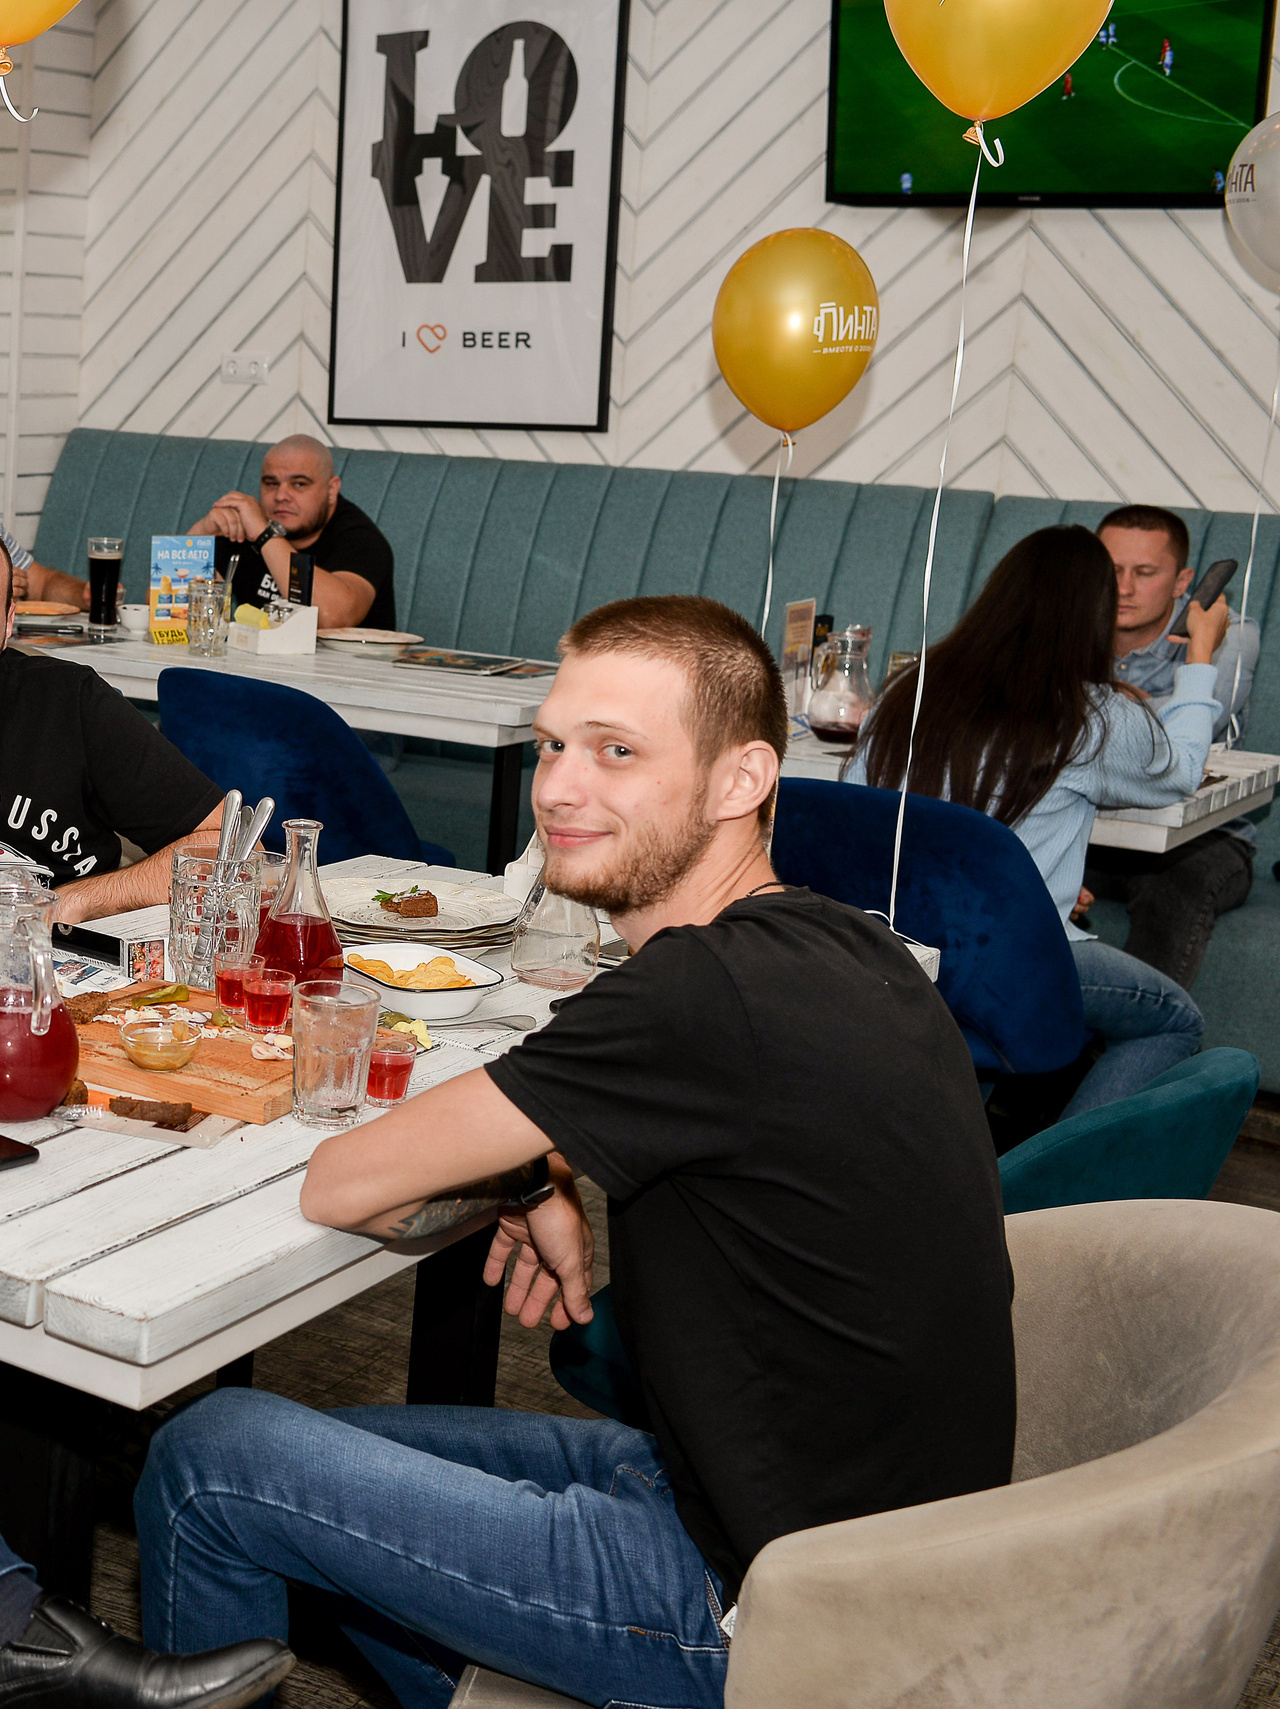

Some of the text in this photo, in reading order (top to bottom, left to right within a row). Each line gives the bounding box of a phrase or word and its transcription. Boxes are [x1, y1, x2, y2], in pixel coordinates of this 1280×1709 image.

[372, 20, 578, 283] LOVE
[813, 302, 877, 342] ПИНТА
[462, 331, 531, 348] BEER
[157, 550, 170, 560] НА
[188, 550, 210, 560] ЛЕТО
[158, 629, 184, 638] БУДЬ
